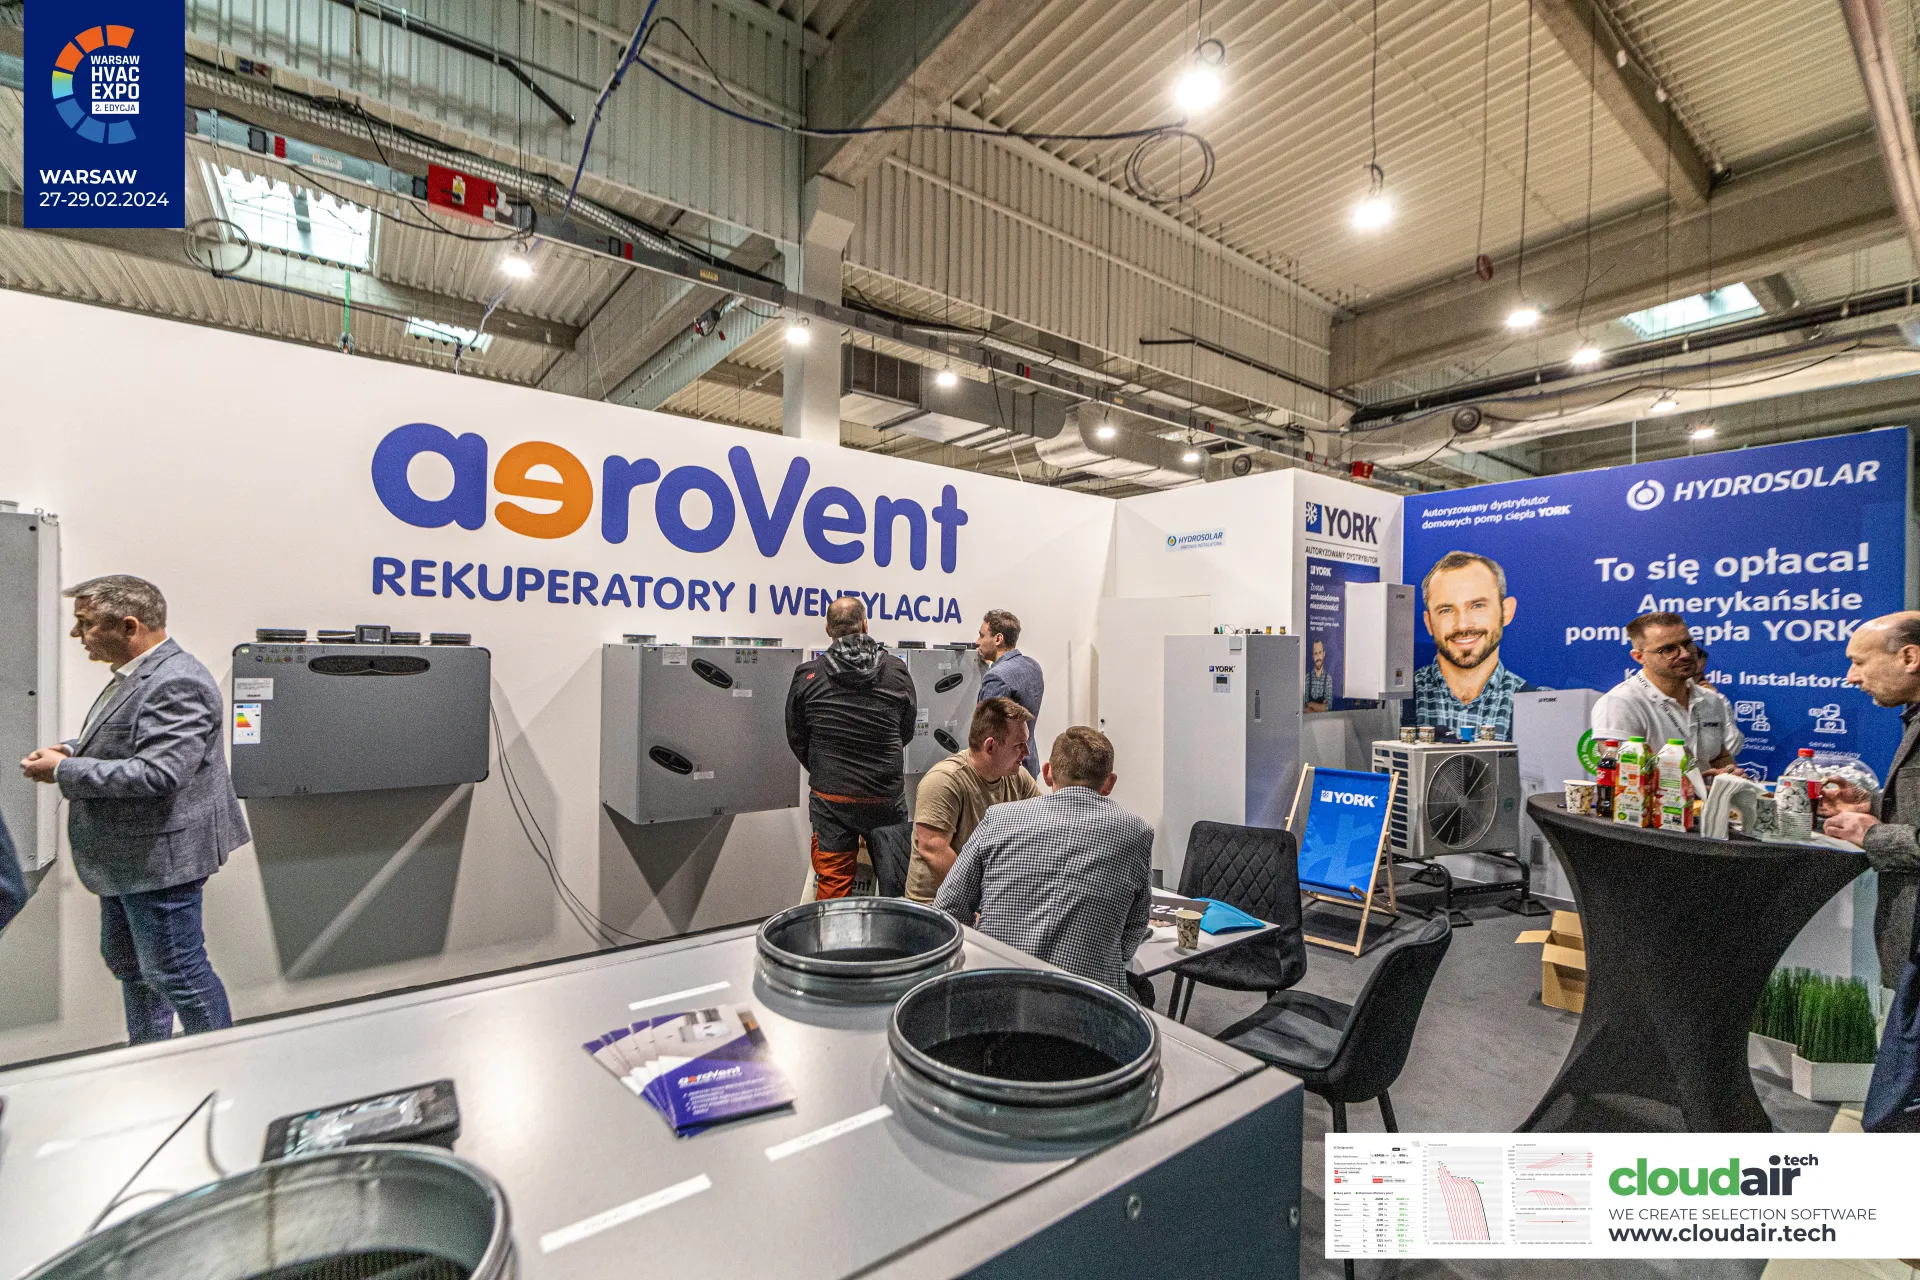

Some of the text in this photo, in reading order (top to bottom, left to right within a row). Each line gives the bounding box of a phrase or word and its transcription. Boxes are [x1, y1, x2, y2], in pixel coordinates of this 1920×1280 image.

[1673, 460, 1881, 502] HYDROSOLAR
[371, 422, 969, 574] aeroVent
[1422, 495, 1550, 518] Autoryzowany dystrybutor
[1422, 515, 1472, 529] domowych
[1474, 513, 1503, 526] pomp
[1505, 509, 1536, 522] ciepła
[1179, 532, 1224, 544] HYDROSOLAR
[1305, 546, 1379, 565] AUTORYZOWANY DYSTRYBUTOR
[1594, 542, 1870, 586] To się opłaca!
[372, 556, 736, 612] REKUPERATORY
[749, 583, 757, 614] I
[1637, 588, 1863, 618] Amerykańskie
[1215, 665, 1234, 673] YORK
[1704, 670, 1733, 684] dla
[1333, 791, 1377, 808] YORK
